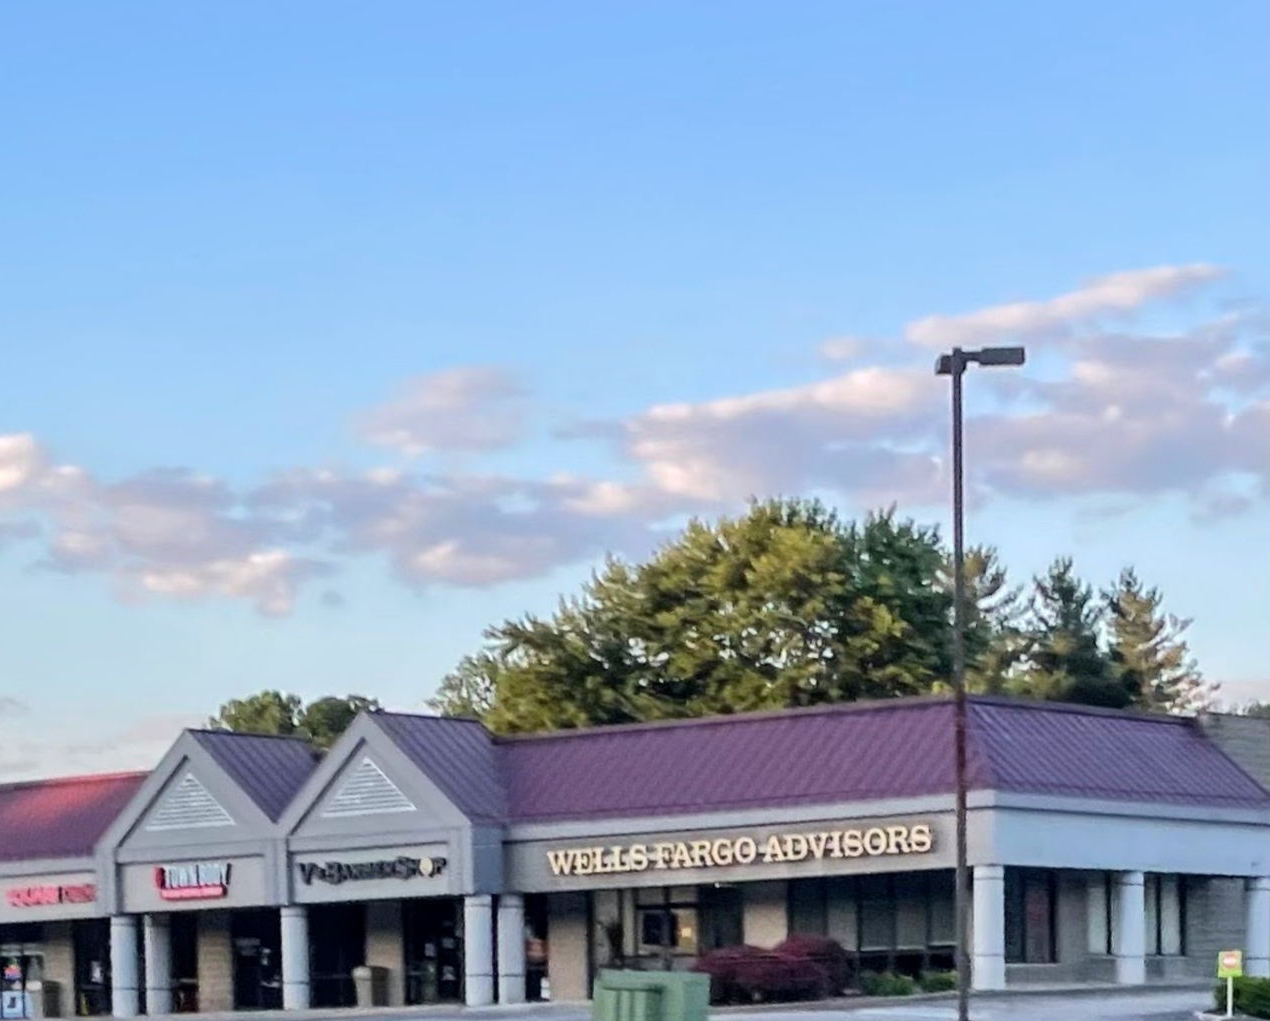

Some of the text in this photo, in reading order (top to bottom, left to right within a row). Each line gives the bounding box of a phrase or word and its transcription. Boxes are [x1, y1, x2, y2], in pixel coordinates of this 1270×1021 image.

[547, 824, 932, 876] WELLS FARGO ADVISORS
